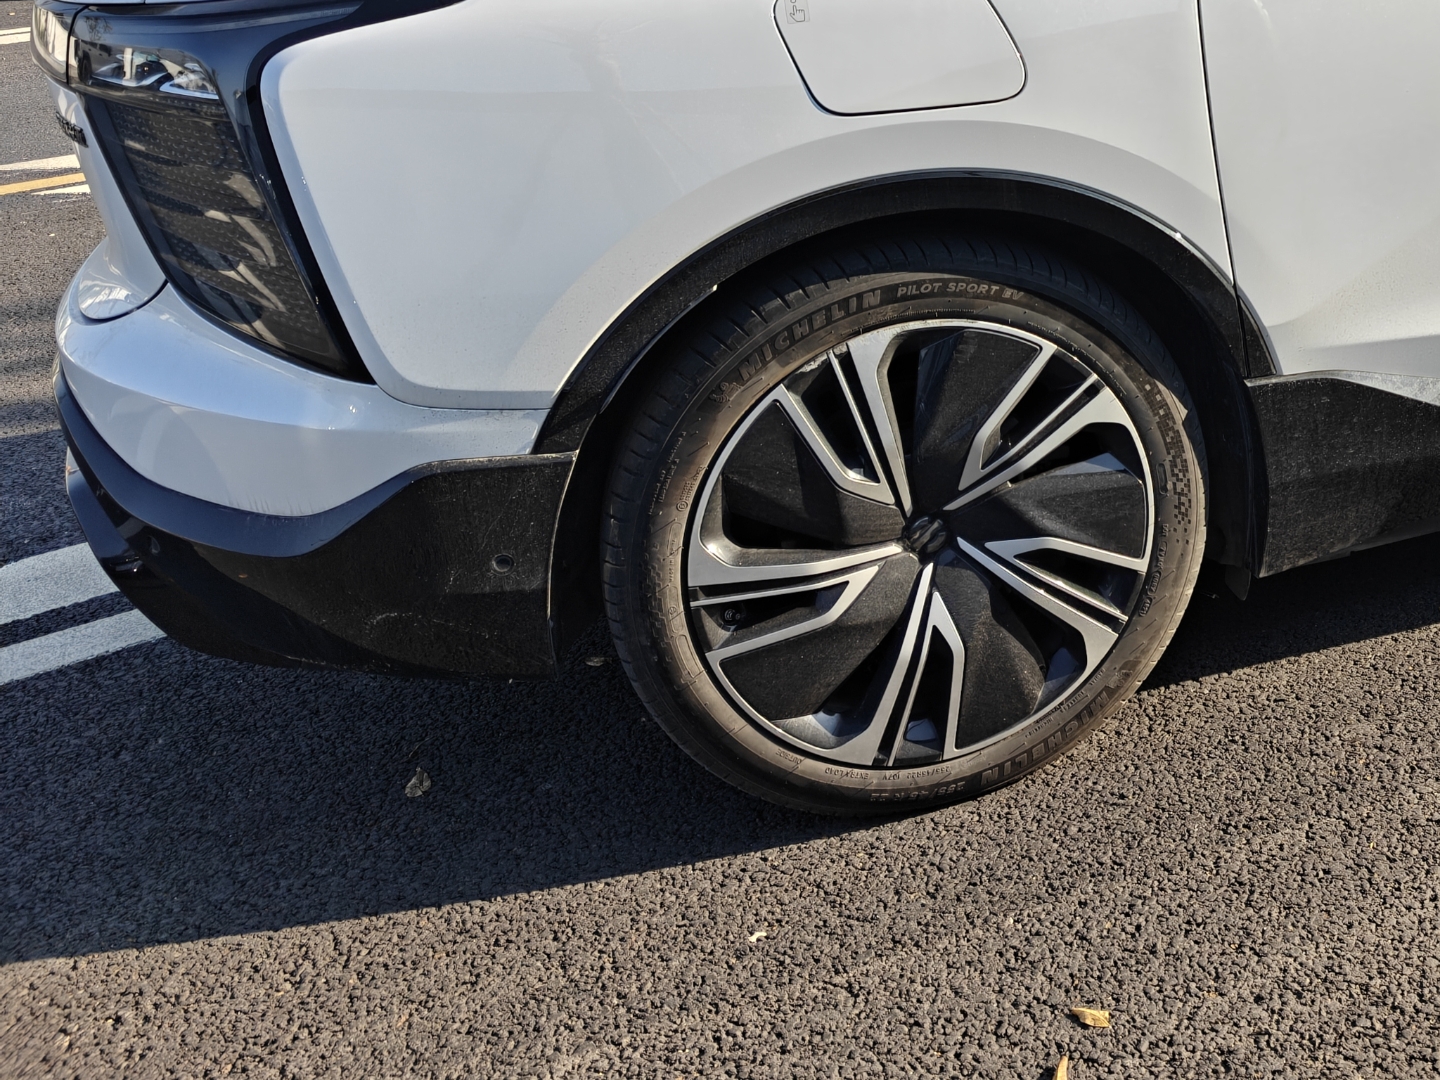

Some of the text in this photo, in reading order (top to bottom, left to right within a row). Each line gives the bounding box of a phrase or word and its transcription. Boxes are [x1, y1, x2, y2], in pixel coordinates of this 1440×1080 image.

[739, 282, 1024, 382] MICHELIN PILOT SPORT EV
[981, 690, 1110, 786] MICHELIN
